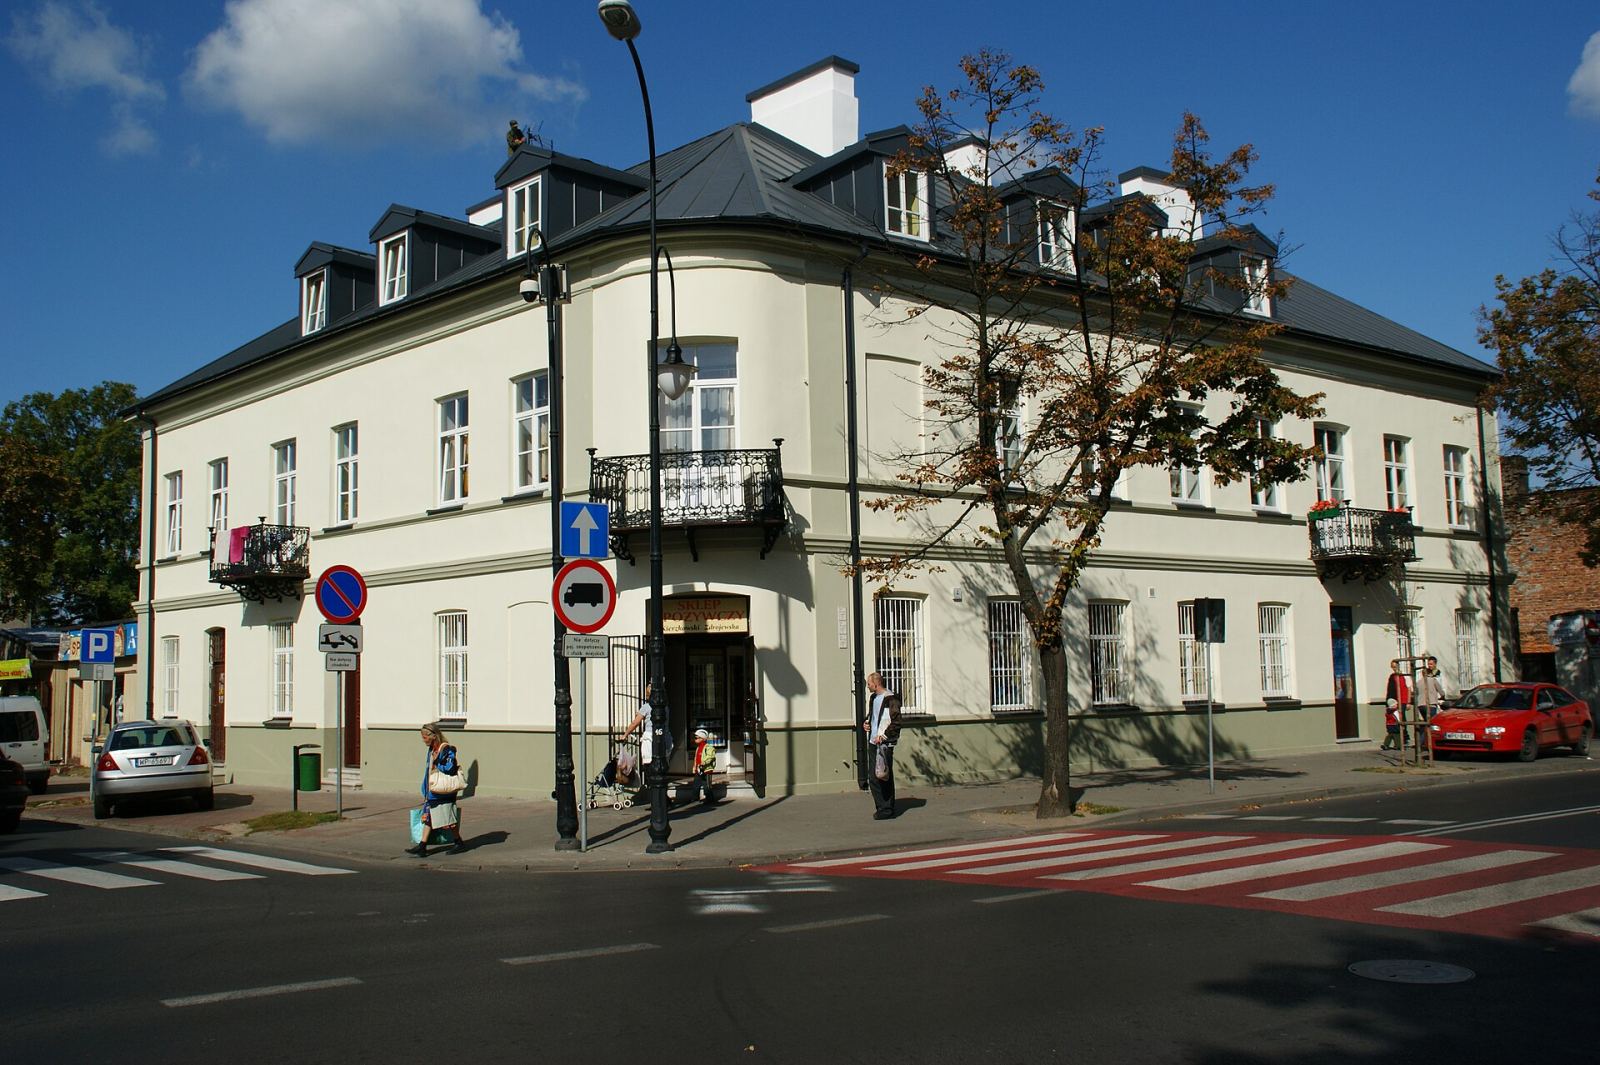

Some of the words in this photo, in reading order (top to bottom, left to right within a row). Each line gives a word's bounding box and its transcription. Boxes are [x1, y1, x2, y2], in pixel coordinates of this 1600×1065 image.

[678, 600, 721, 609] SKLEP
[663, 610, 744, 622] POŻYWCZY
[89, 633, 108, 659] P
